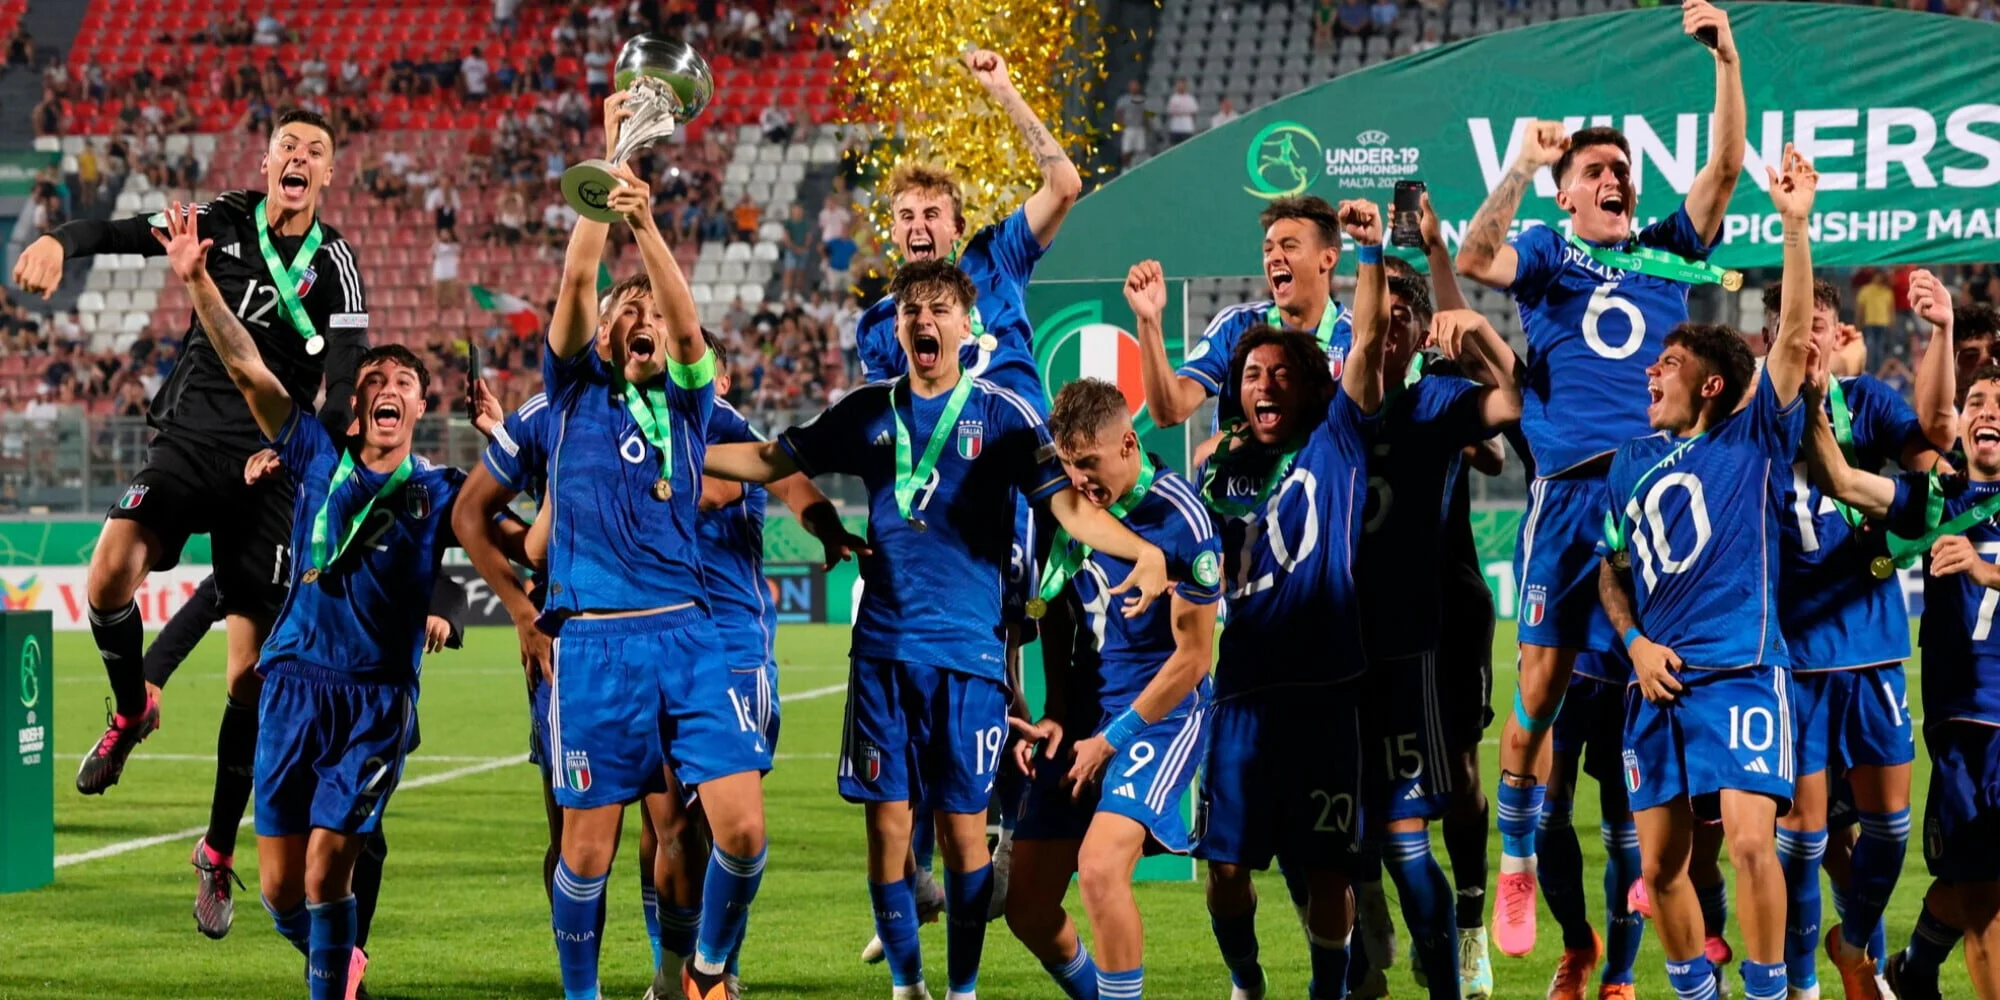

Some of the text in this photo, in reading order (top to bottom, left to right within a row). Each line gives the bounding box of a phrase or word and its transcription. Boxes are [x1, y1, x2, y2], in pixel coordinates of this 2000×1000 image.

[1325, 147, 1419, 164] UNDER-19
[1356, 130, 1389, 146] UEFA
[1467, 104, 2000, 197] WNNERS
[1326, 163, 1418, 175] CHAMPIONSHIP
[1339, 177, 1375, 188] MALTA
[236, 279, 279, 328] 12
[1582, 282, 1646, 360] 6
[960, 426, 981, 435] ITALIA
[364, 508, 396, 552] 2
[1625, 471, 1712, 596] 10
[975, 726, 1002, 775] 19
[1728, 705, 1774, 752] 10
[361, 756, 388, 797] 2
[1122, 740, 1155, 778] 9
[1383, 732, 1425, 780] 15
[1310, 789, 1352, 833] 20
[556, 930, 595, 943] ITALIA
